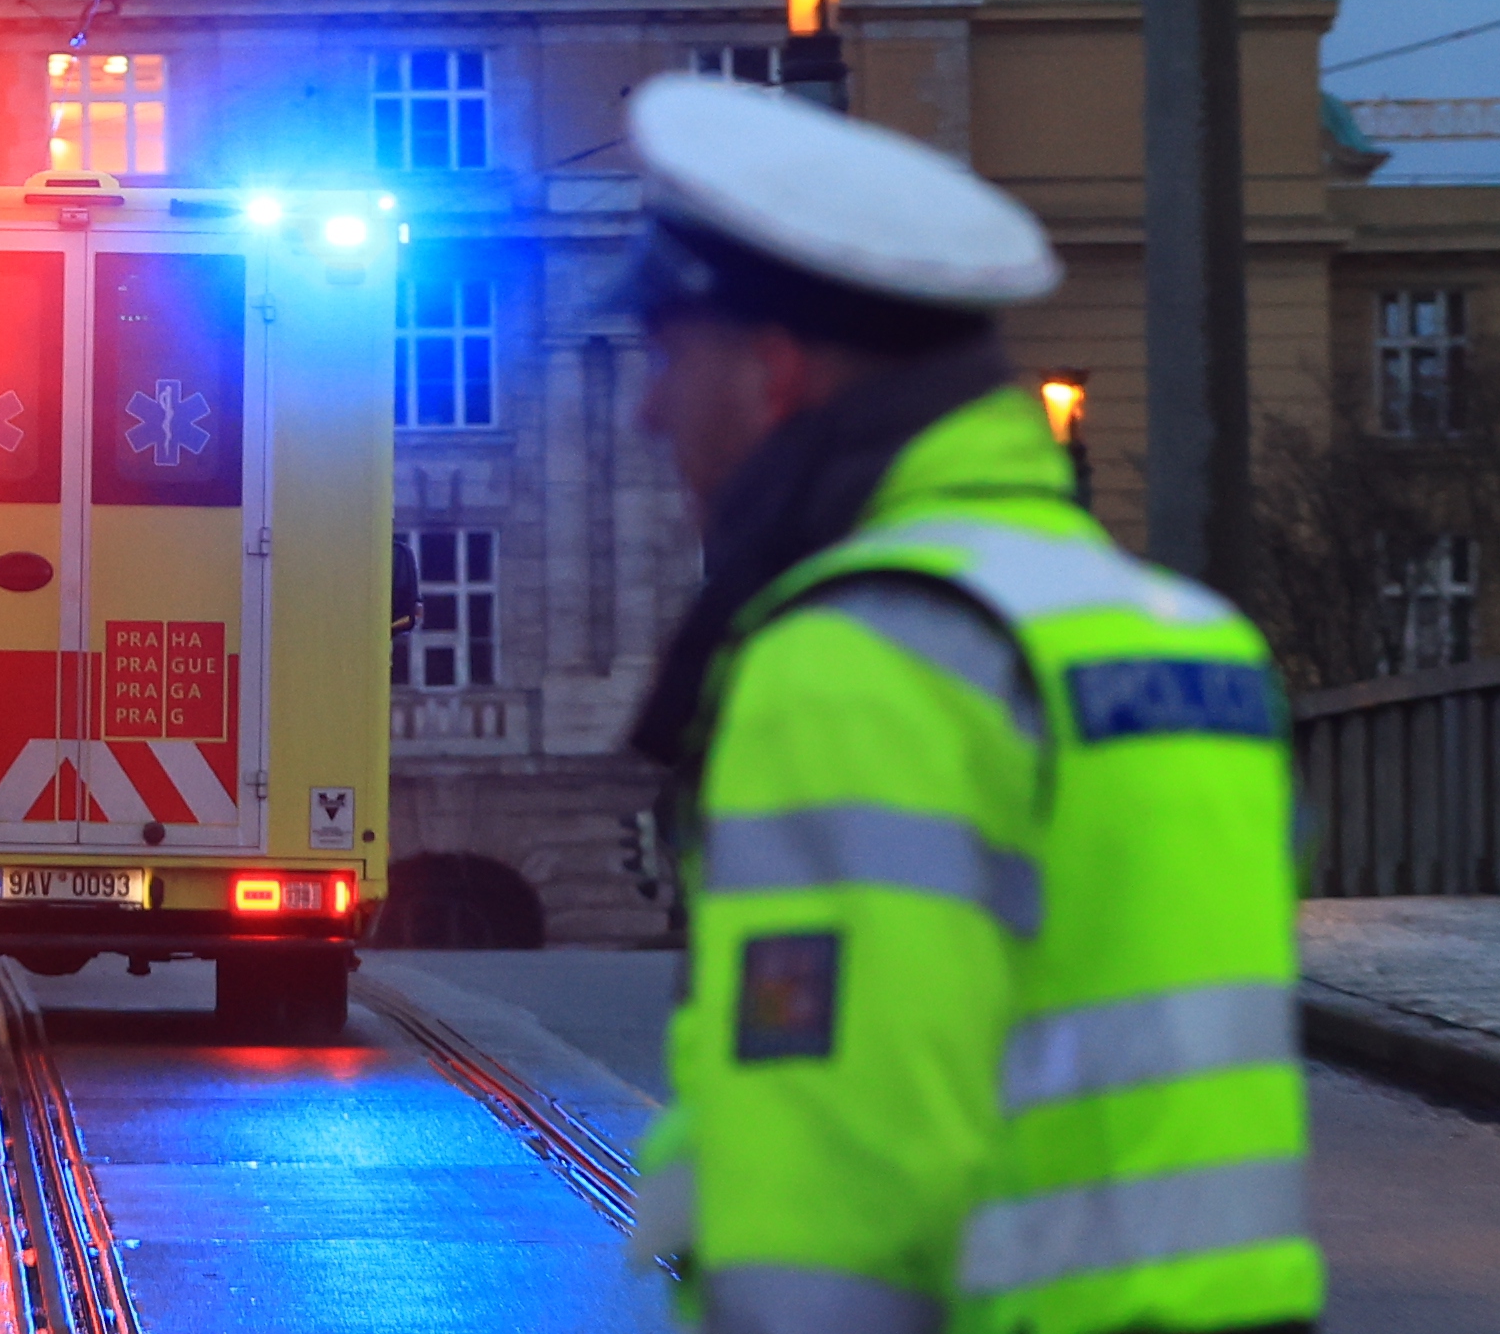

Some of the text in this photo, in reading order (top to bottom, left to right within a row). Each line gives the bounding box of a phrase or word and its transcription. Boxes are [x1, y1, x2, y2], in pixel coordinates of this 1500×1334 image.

[117, 631, 202, 648] PRA HA
[116, 656, 216, 674] PRA GUE
[116, 682, 202, 699] PRA GA
[116, 708, 184, 725] PRA G
[9, 871, 51, 896] 9AV
[72, 872, 131, 897] 0093
